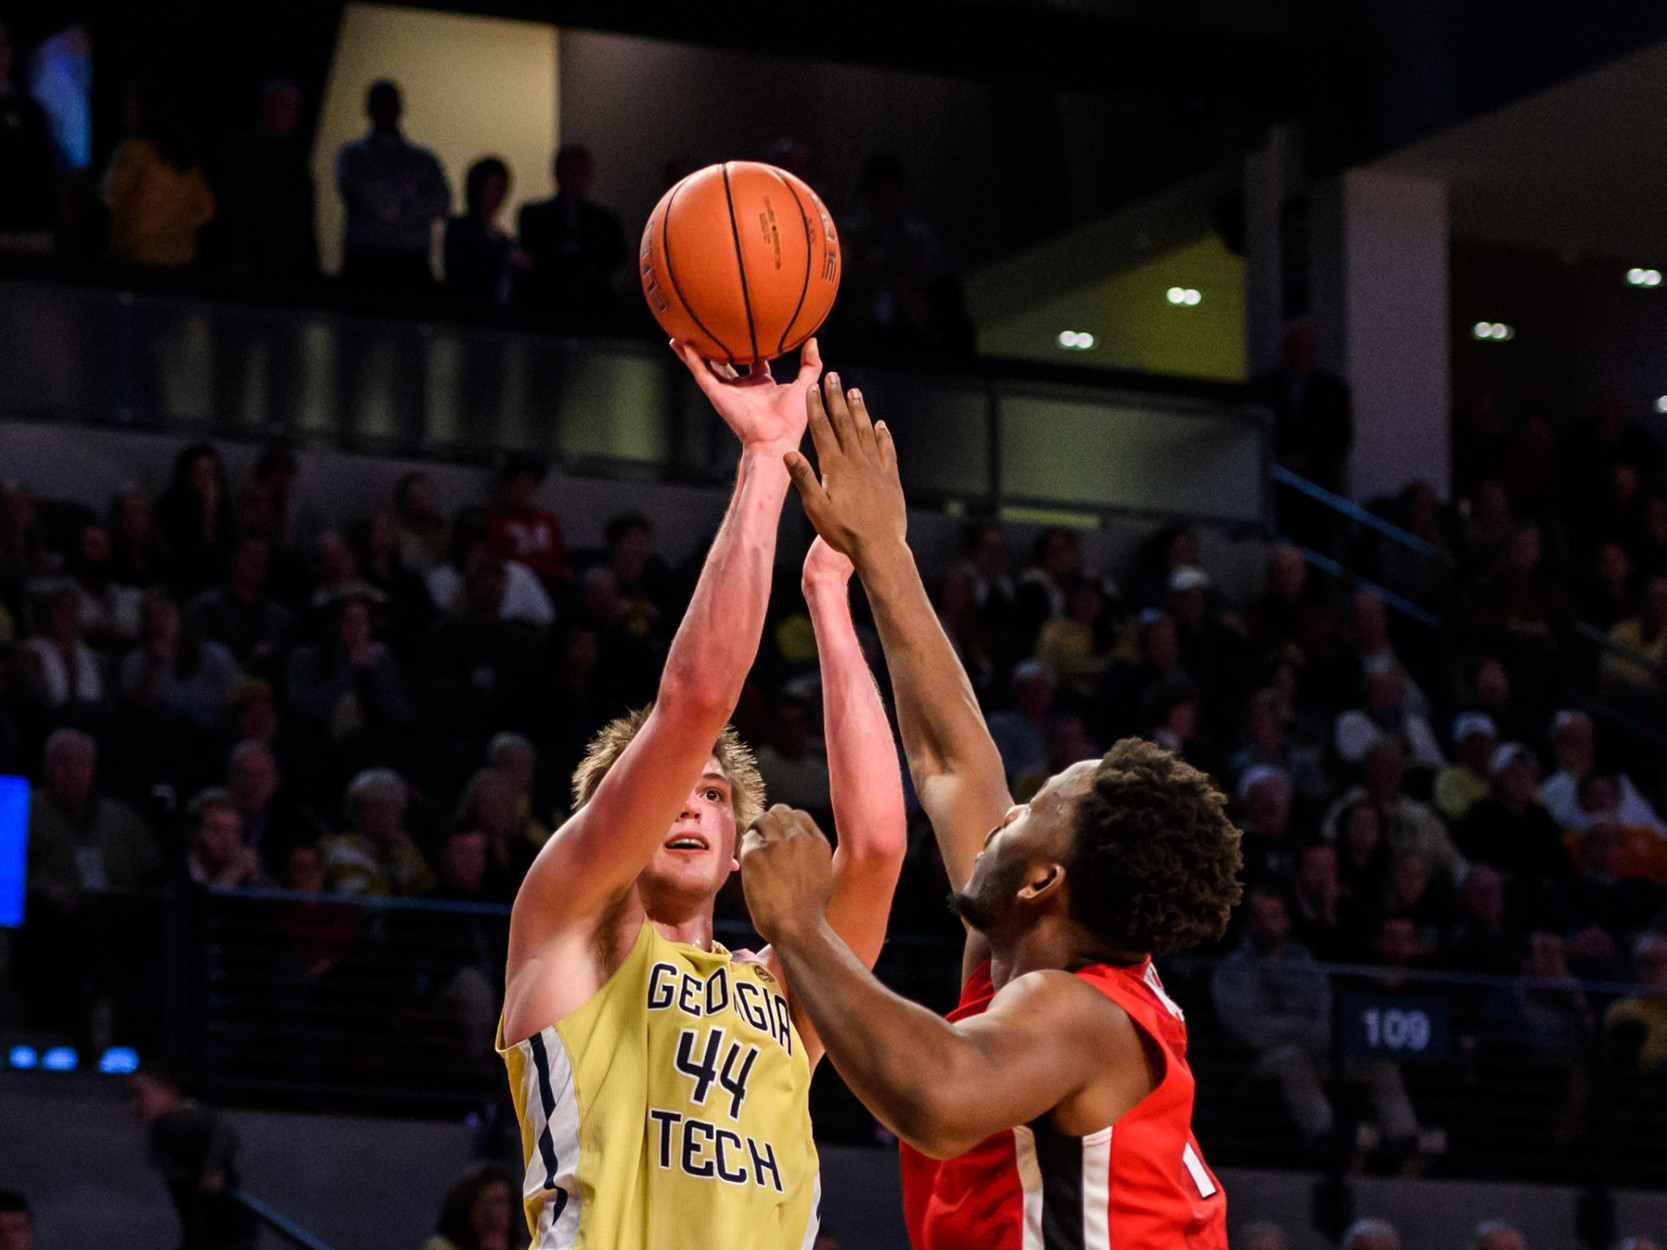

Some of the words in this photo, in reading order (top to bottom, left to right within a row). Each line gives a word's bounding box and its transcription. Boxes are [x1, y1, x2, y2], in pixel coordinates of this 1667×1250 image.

[1363, 1008, 1430, 1050] 109
[674, 1026, 761, 1121] 44
[649, 1108, 785, 1194] TECH
